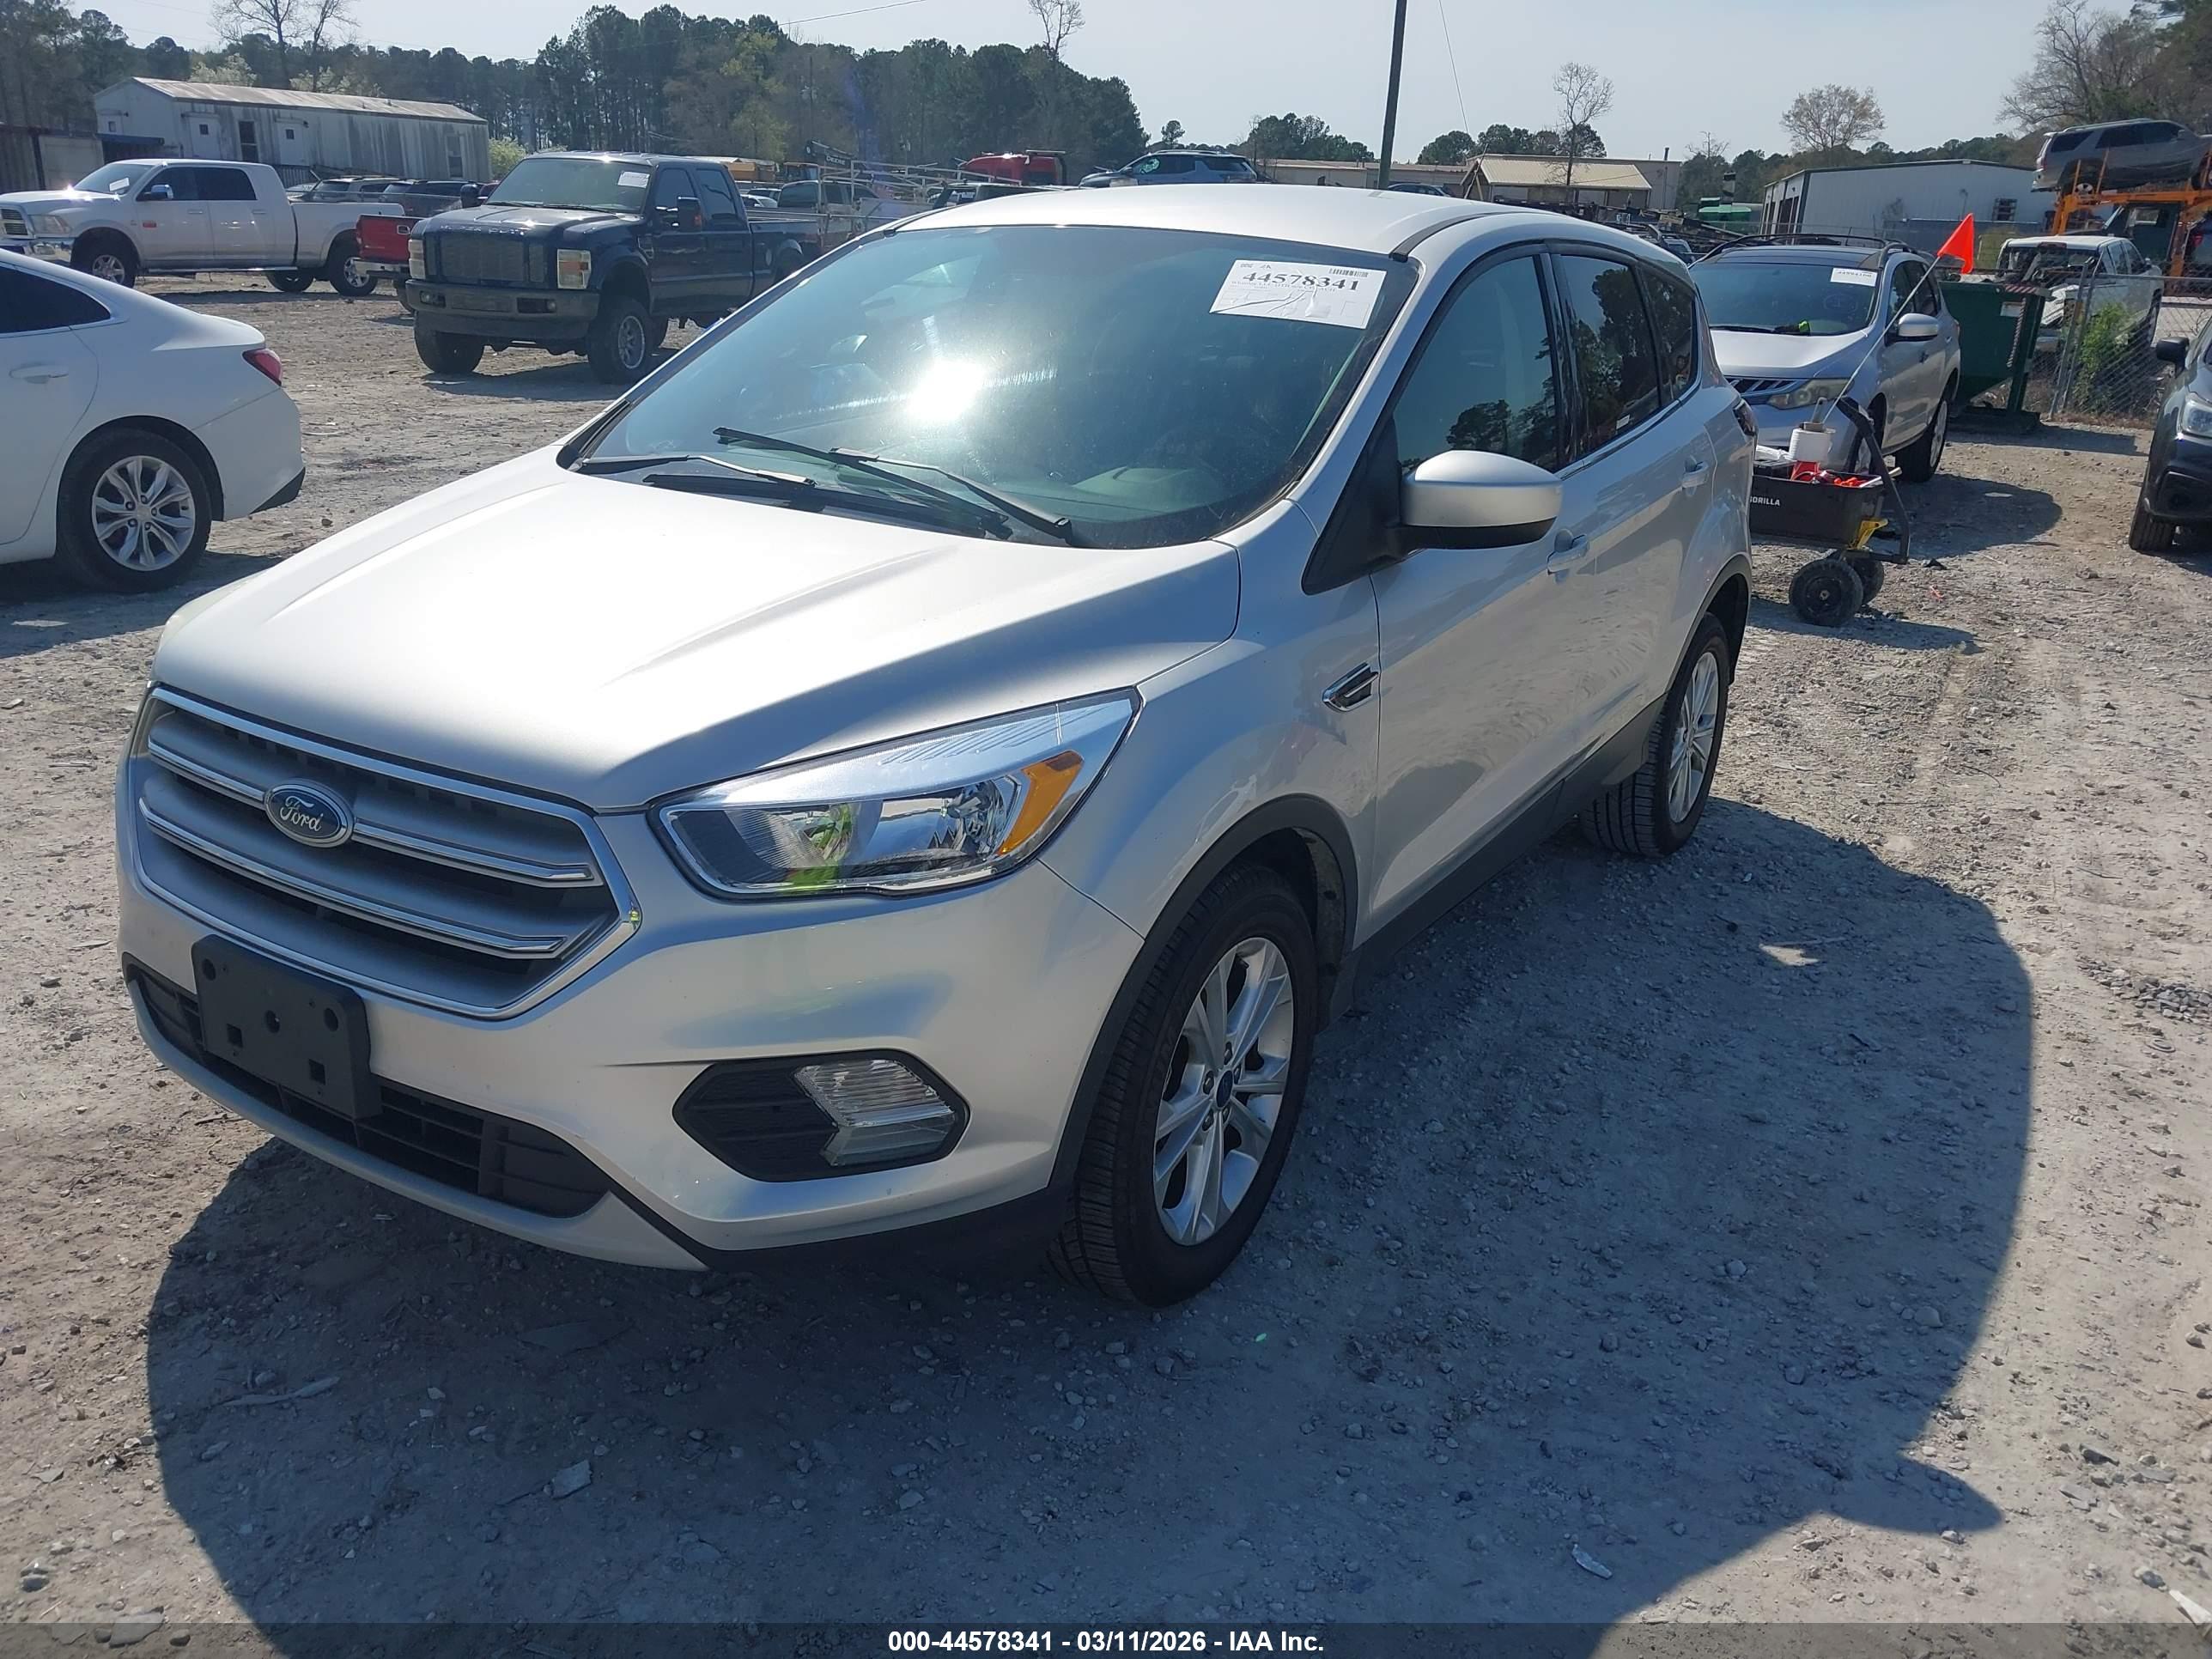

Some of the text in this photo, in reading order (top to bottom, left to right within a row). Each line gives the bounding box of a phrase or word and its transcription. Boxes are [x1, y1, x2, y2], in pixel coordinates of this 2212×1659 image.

[825, 155, 846, 166] DEERE
[1242, 271, 1359, 291] 44578341
[279, 795, 325, 832] Ford
